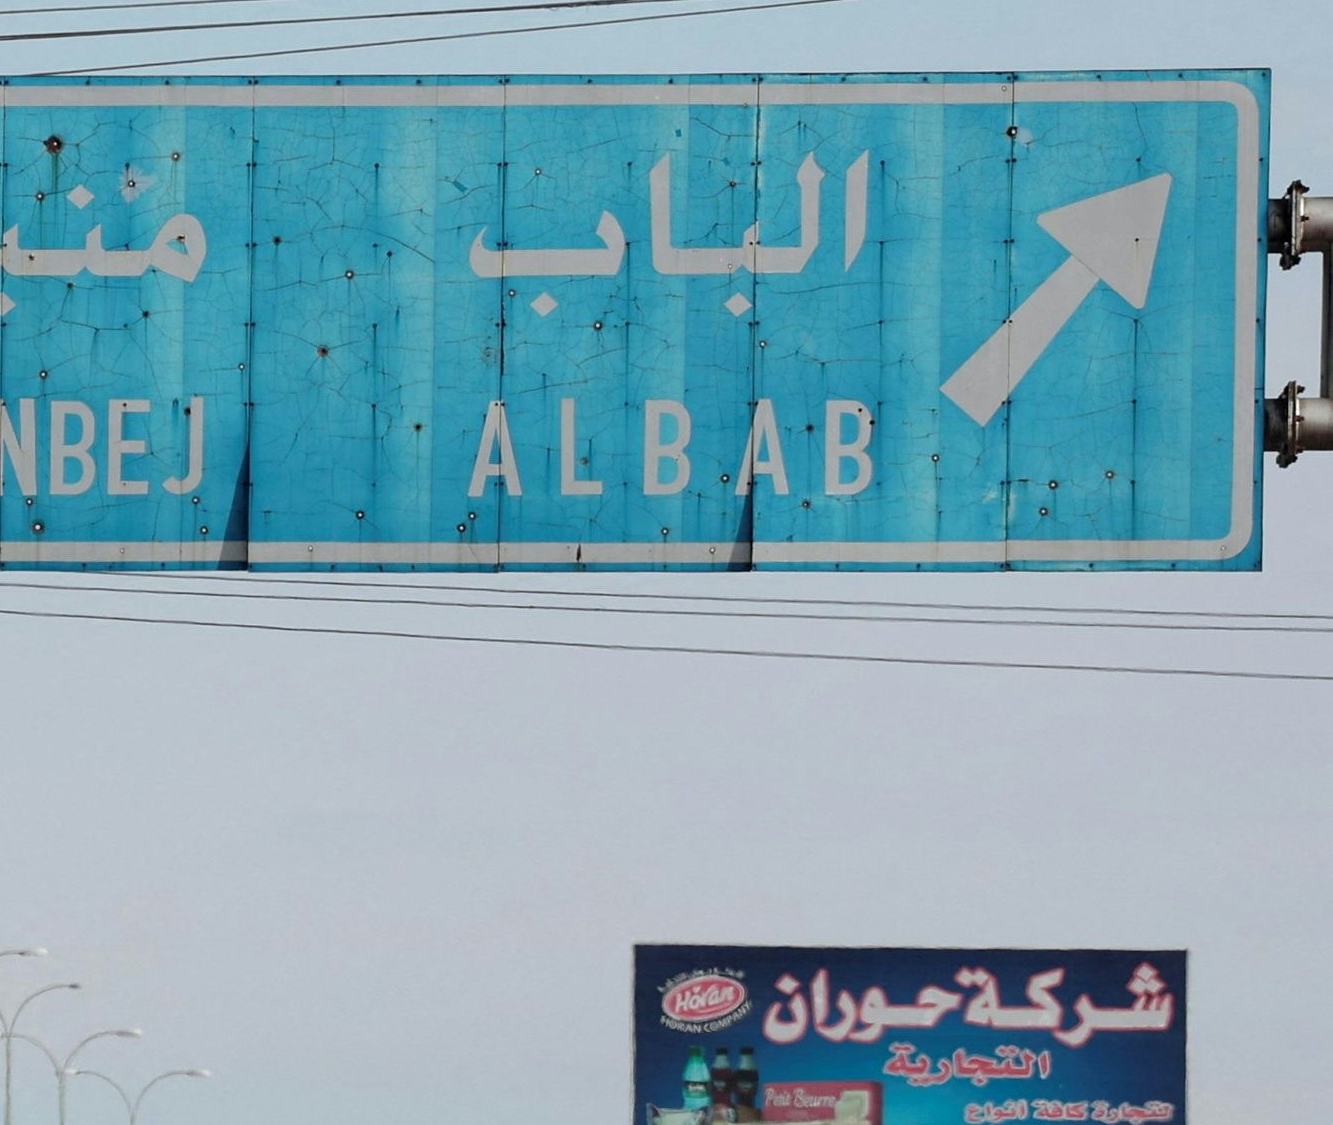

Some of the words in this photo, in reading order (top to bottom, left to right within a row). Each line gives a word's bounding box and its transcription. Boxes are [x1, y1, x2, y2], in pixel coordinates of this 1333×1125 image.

[469, 150, 870, 317] الباب
[763, 967, 963, 1044] حوران
[954, 962, 1174, 1048] شركة
[884, 1041, 1052, 1087] التجارية
